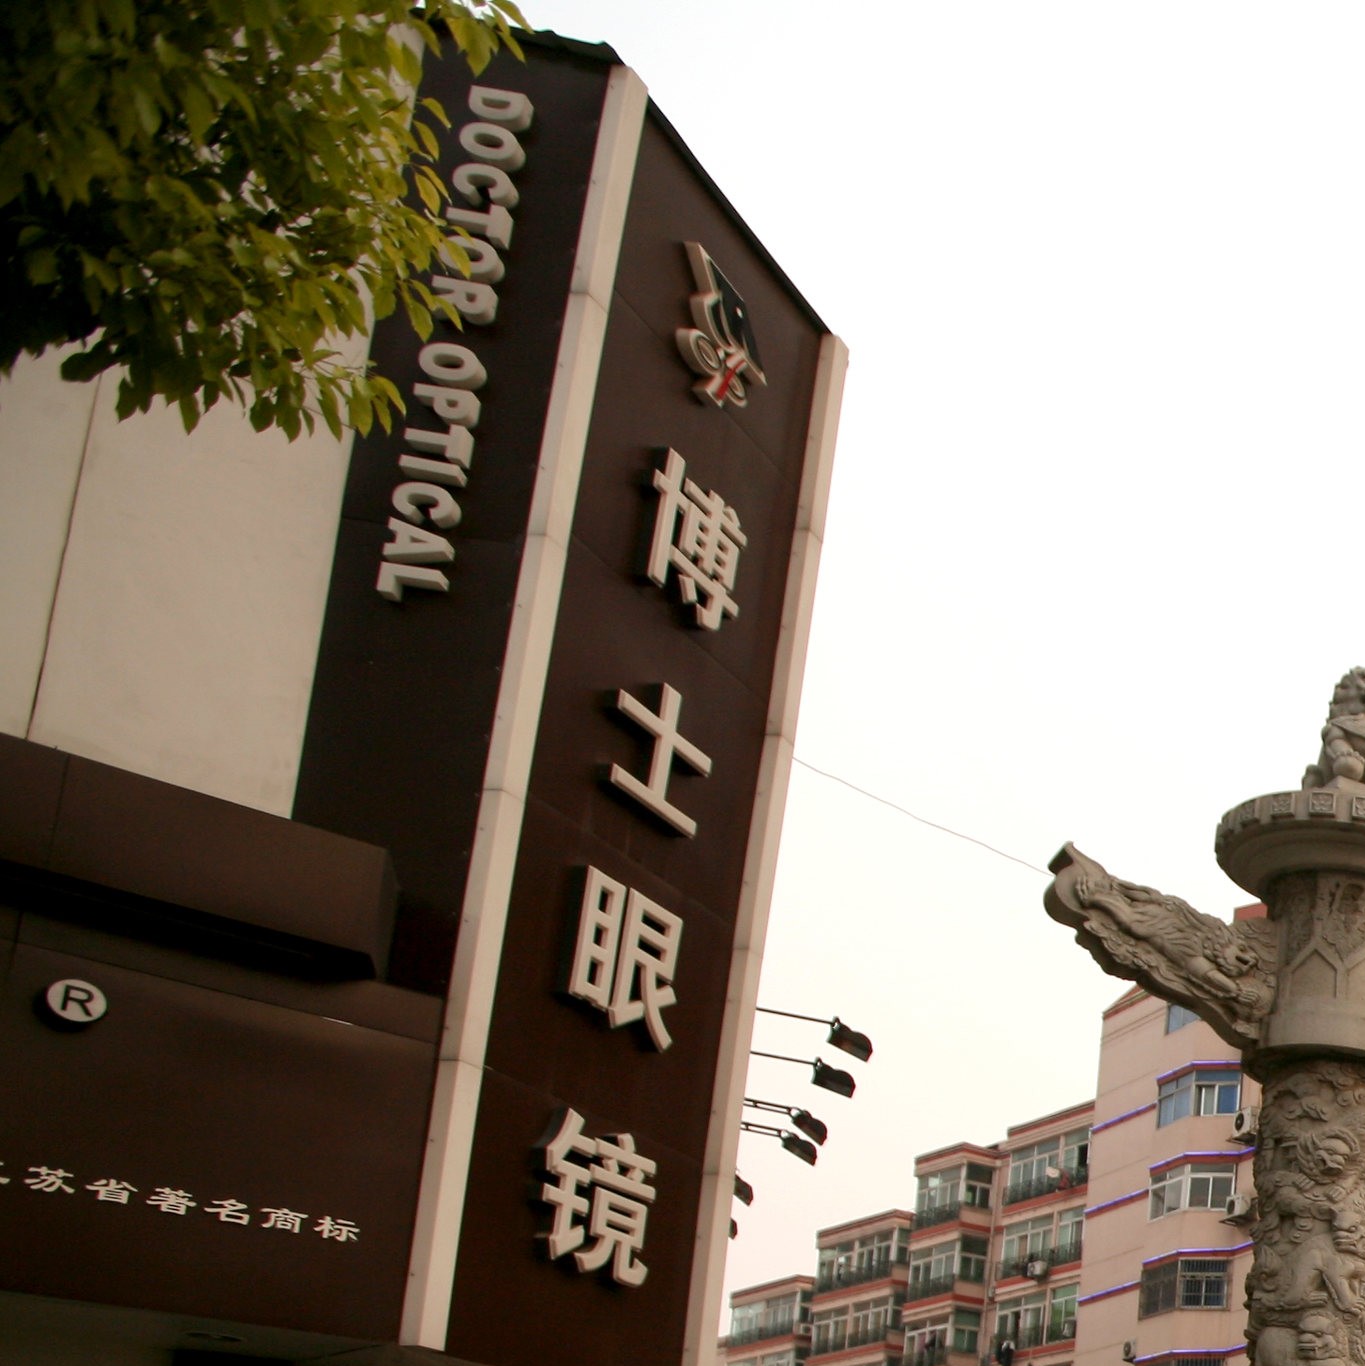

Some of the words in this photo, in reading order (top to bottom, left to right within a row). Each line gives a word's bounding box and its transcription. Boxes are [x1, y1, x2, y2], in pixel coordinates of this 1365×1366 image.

[429, 86, 535, 326] DOCTOR
[377, 342, 488, 599] OPTICAL
[541, 448, 748, 1287] 博士眼镜
